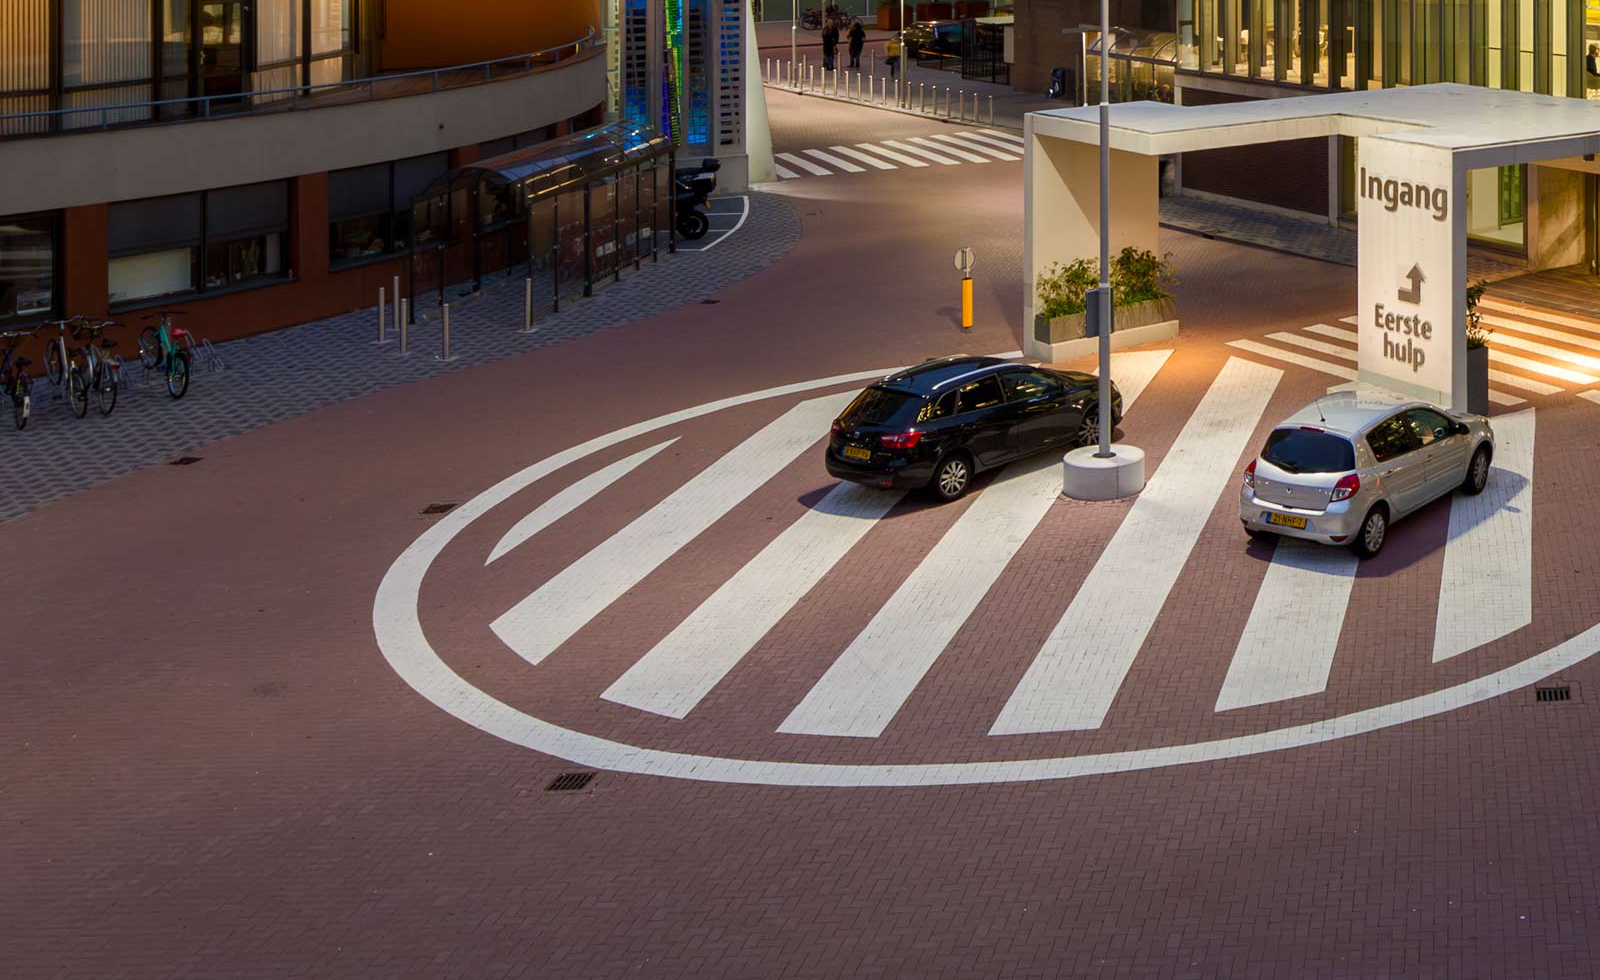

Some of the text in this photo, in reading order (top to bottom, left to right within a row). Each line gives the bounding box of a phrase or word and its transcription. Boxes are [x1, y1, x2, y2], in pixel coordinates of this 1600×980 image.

[1361, 167, 1448, 221] Ingang
[1375, 303, 1432, 340] Eerste
[1384, 332, 1425, 371] hulp
